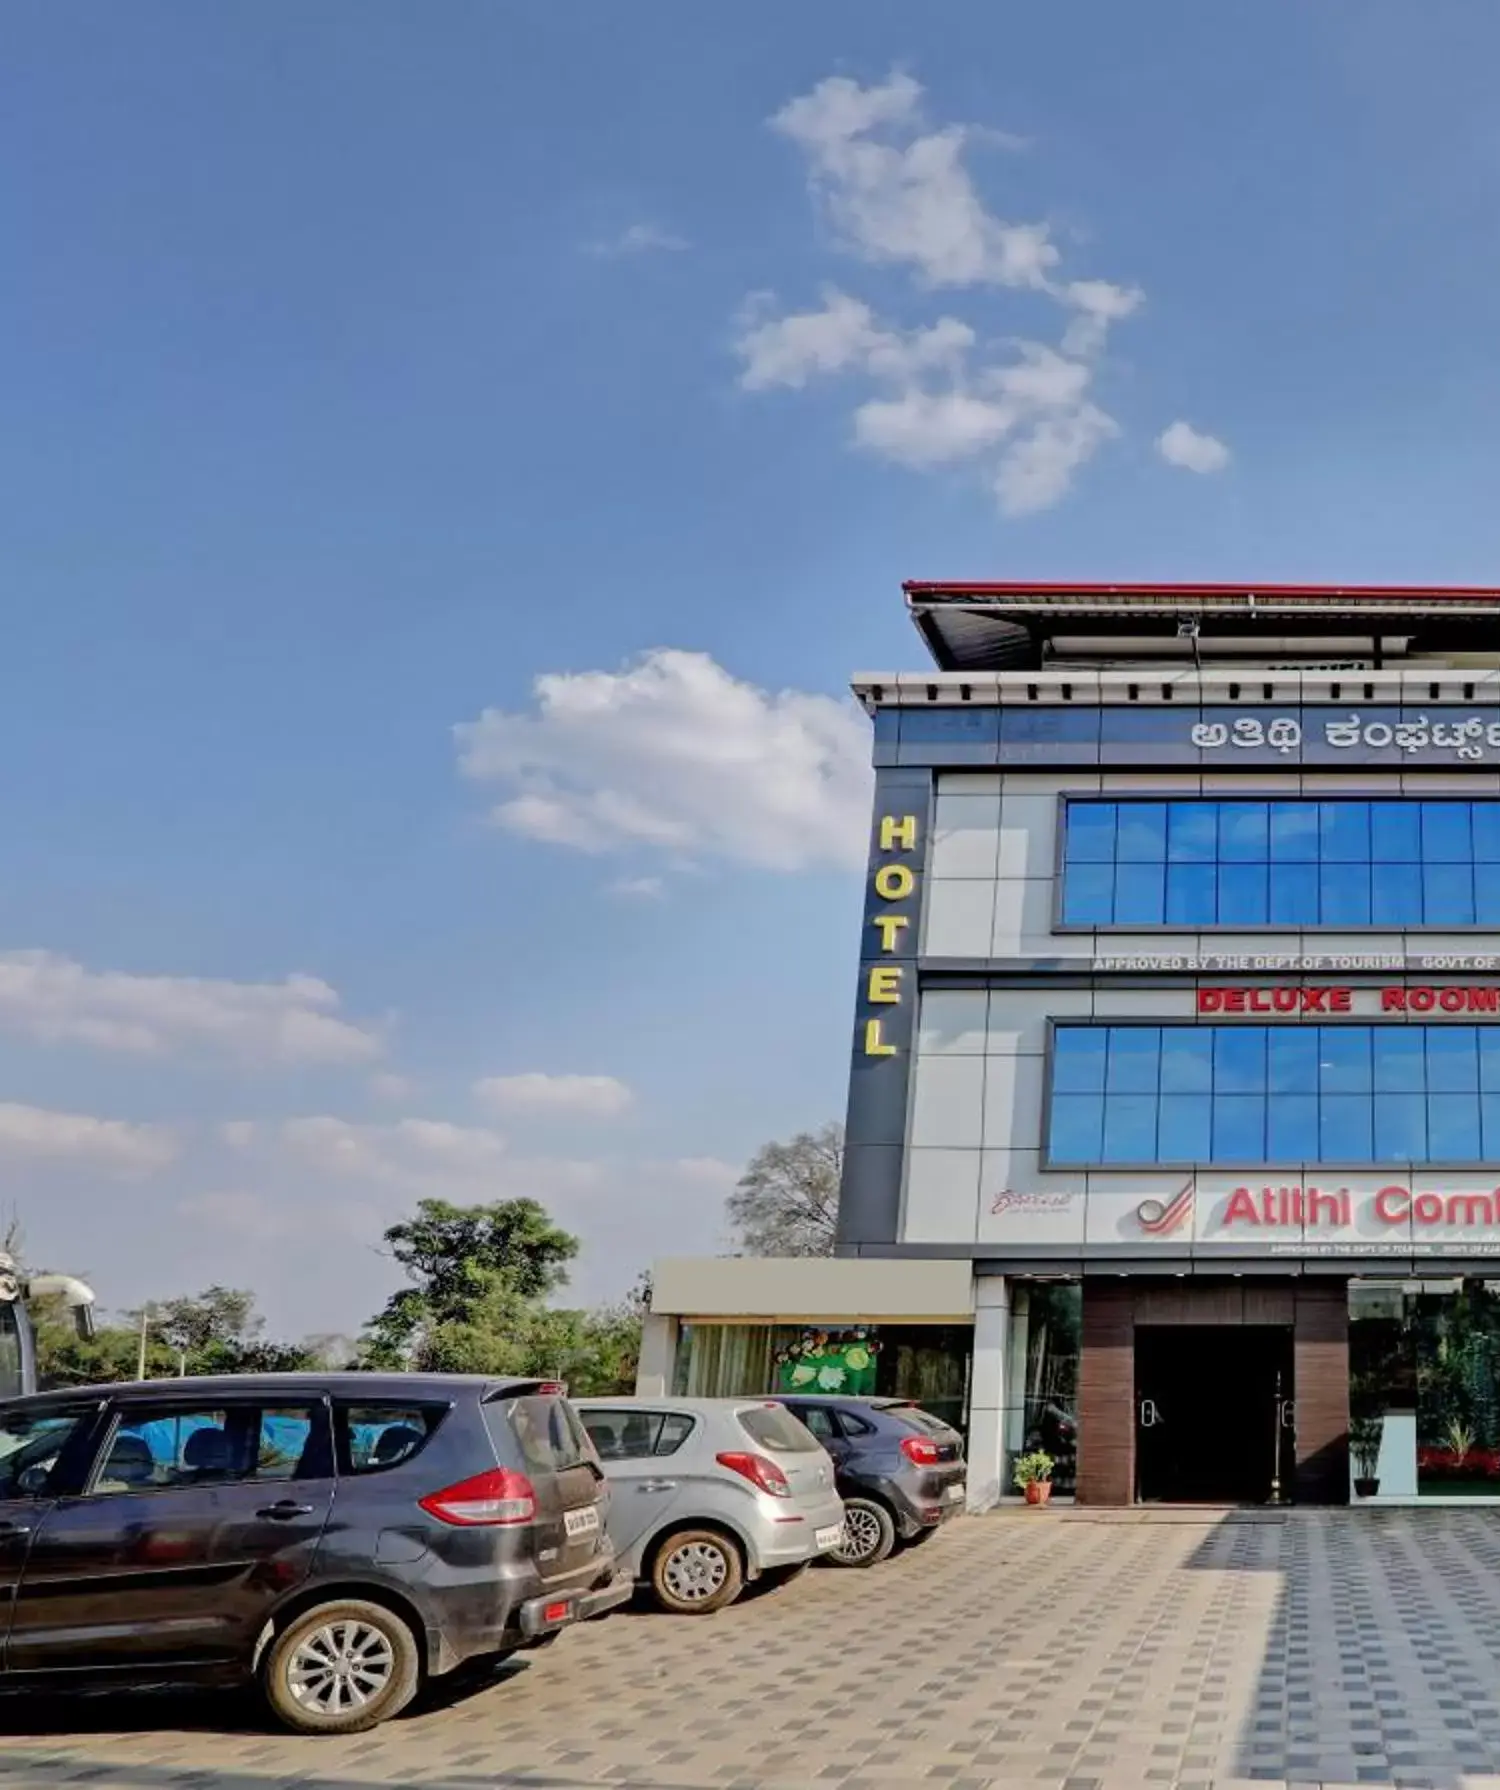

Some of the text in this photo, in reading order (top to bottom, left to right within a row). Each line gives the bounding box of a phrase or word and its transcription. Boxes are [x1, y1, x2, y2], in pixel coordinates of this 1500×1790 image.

[865, 815, 916, 1056] HOTEL
[1093, 957, 1182, 970] APPROVED
[1187, 957, 1210, 970] BY
[1216, 957, 1249, 970] THE
[1302, 957, 1324, 970] OF
[1329, 956, 1405, 969] TOURISM
[1473, 956, 1497, 969] OF
[1198, 987, 1353, 1013] DELUXE
[1222, 1186, 1352, 1226] Atithi
